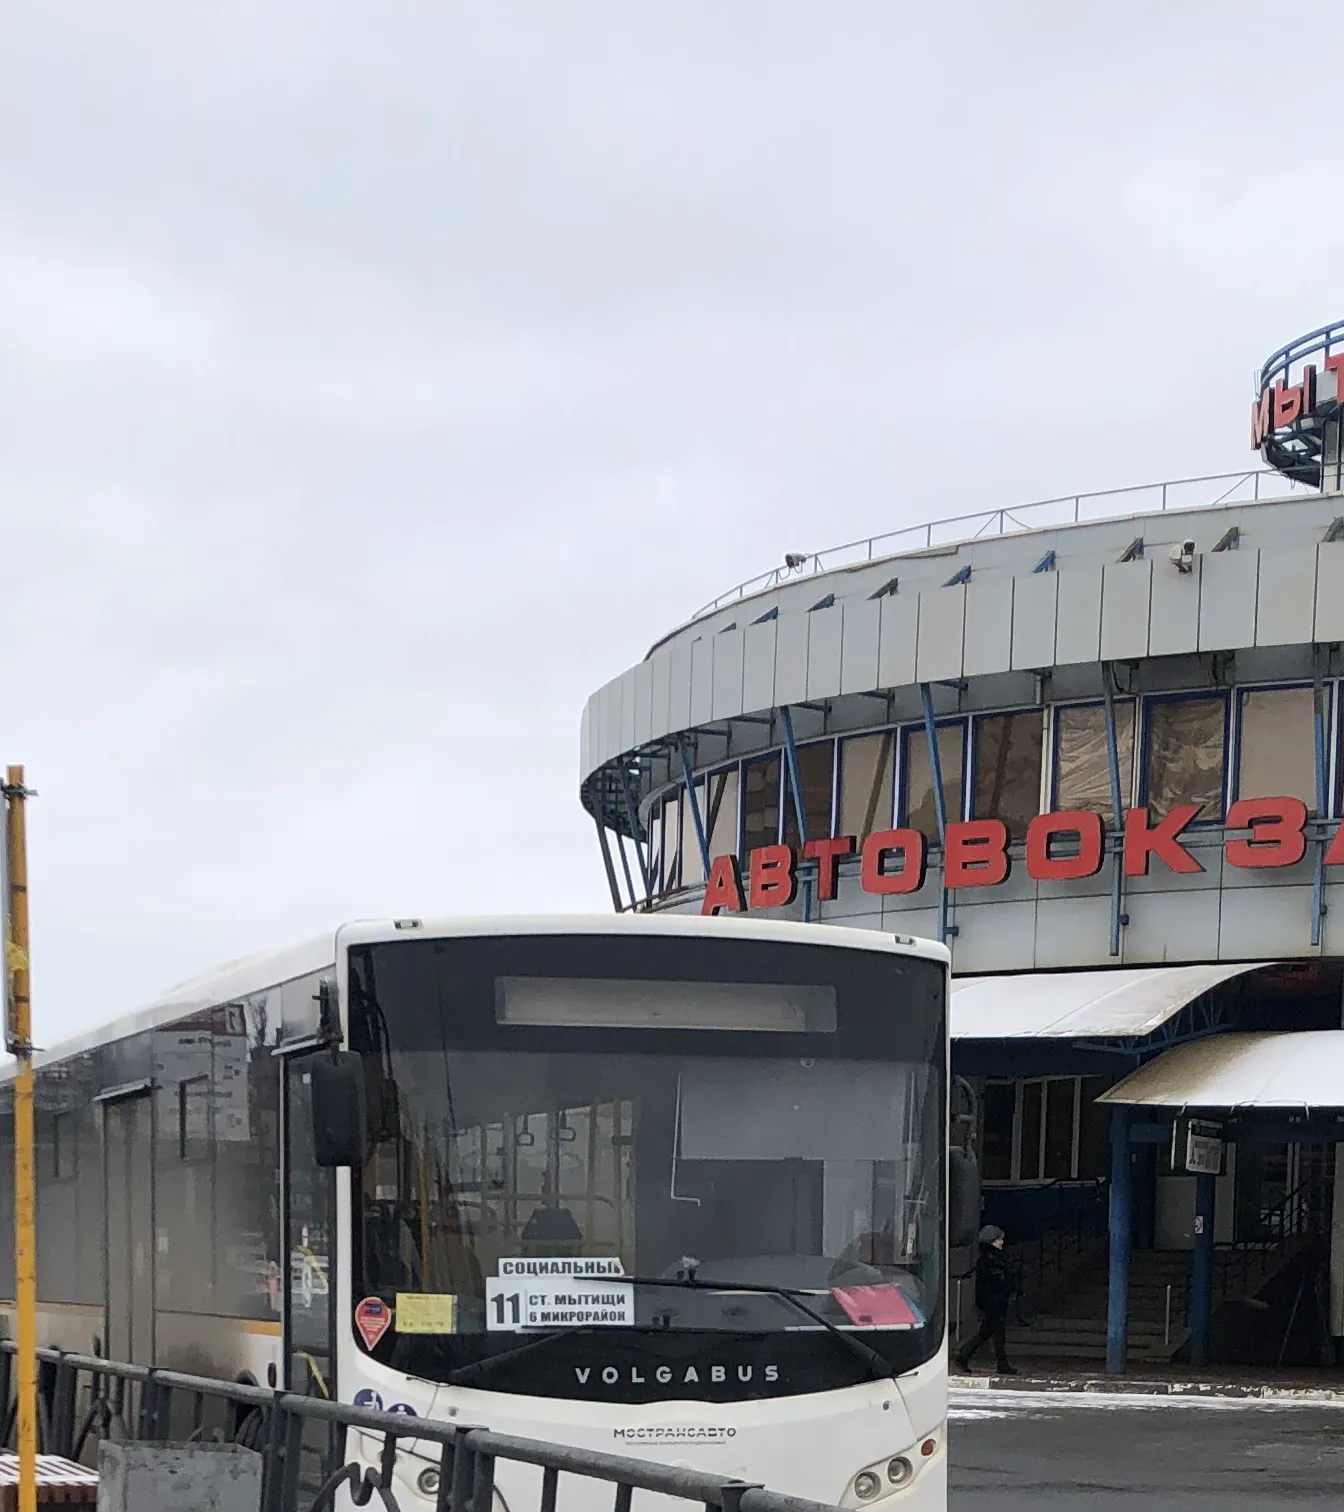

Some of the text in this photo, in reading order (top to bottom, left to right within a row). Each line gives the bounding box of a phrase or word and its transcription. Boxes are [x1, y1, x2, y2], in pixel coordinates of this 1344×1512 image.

[529, 1293, 626, 1307] СТ. МЫТИЩИ
[490, 1293, 521, 1324] 11
[529, 1309, 626, 1323] 6 МИКРОРАЙОН
[575, 1365, 779, 1385] VOLGABUS
[613, 1427, 737, 1439] МОСТРАНСАВТО
